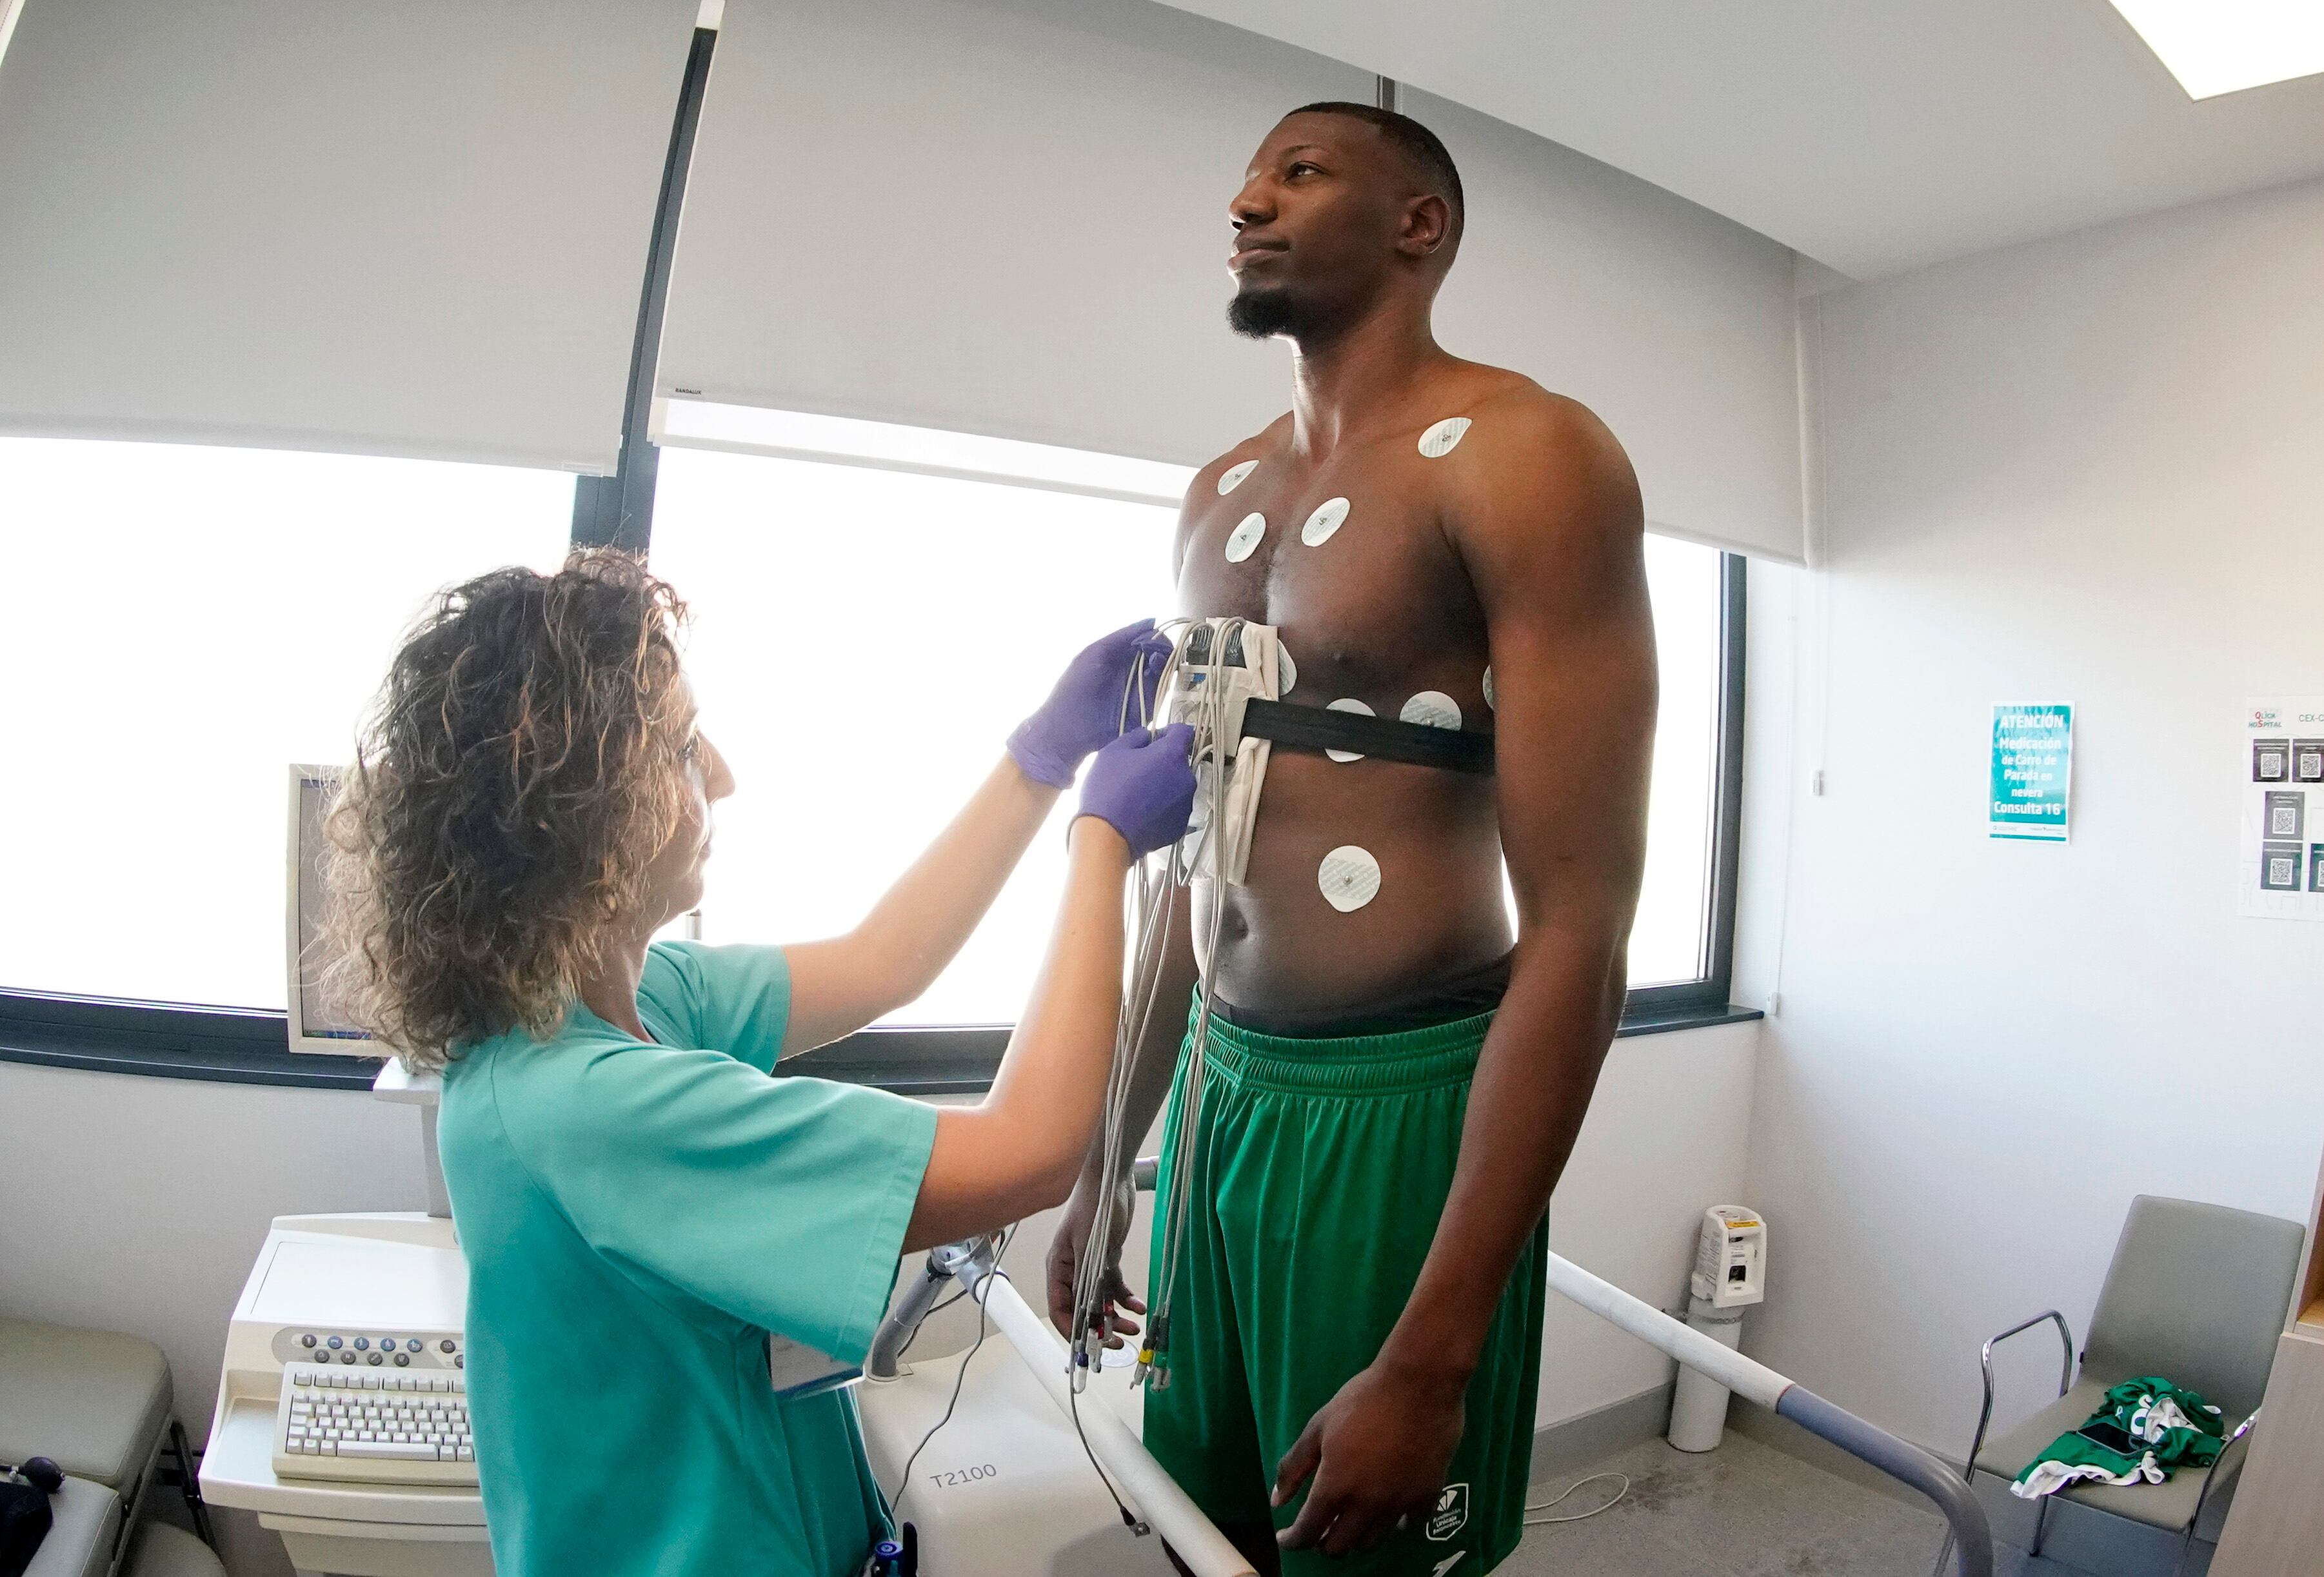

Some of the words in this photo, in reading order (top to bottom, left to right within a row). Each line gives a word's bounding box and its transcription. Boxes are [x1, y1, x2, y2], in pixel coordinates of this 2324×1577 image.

[2000, 711, 2064, 728] ATENCIÓN
[2000, 737, 2061, 749] Medicación
[2002, 755, 2014, 765] de
[2016, 755, 2041, 765] Carro
[2044, 755, 2057, 765] de
[2004, 769, 2038, 780] Parada
[2011, 788, 2043, 797] nevera
[1994, 801, 2042, 815] Consulta
[2045, 803, 2061, 815] 16
[929, 1464, 997, 1489] T2100
